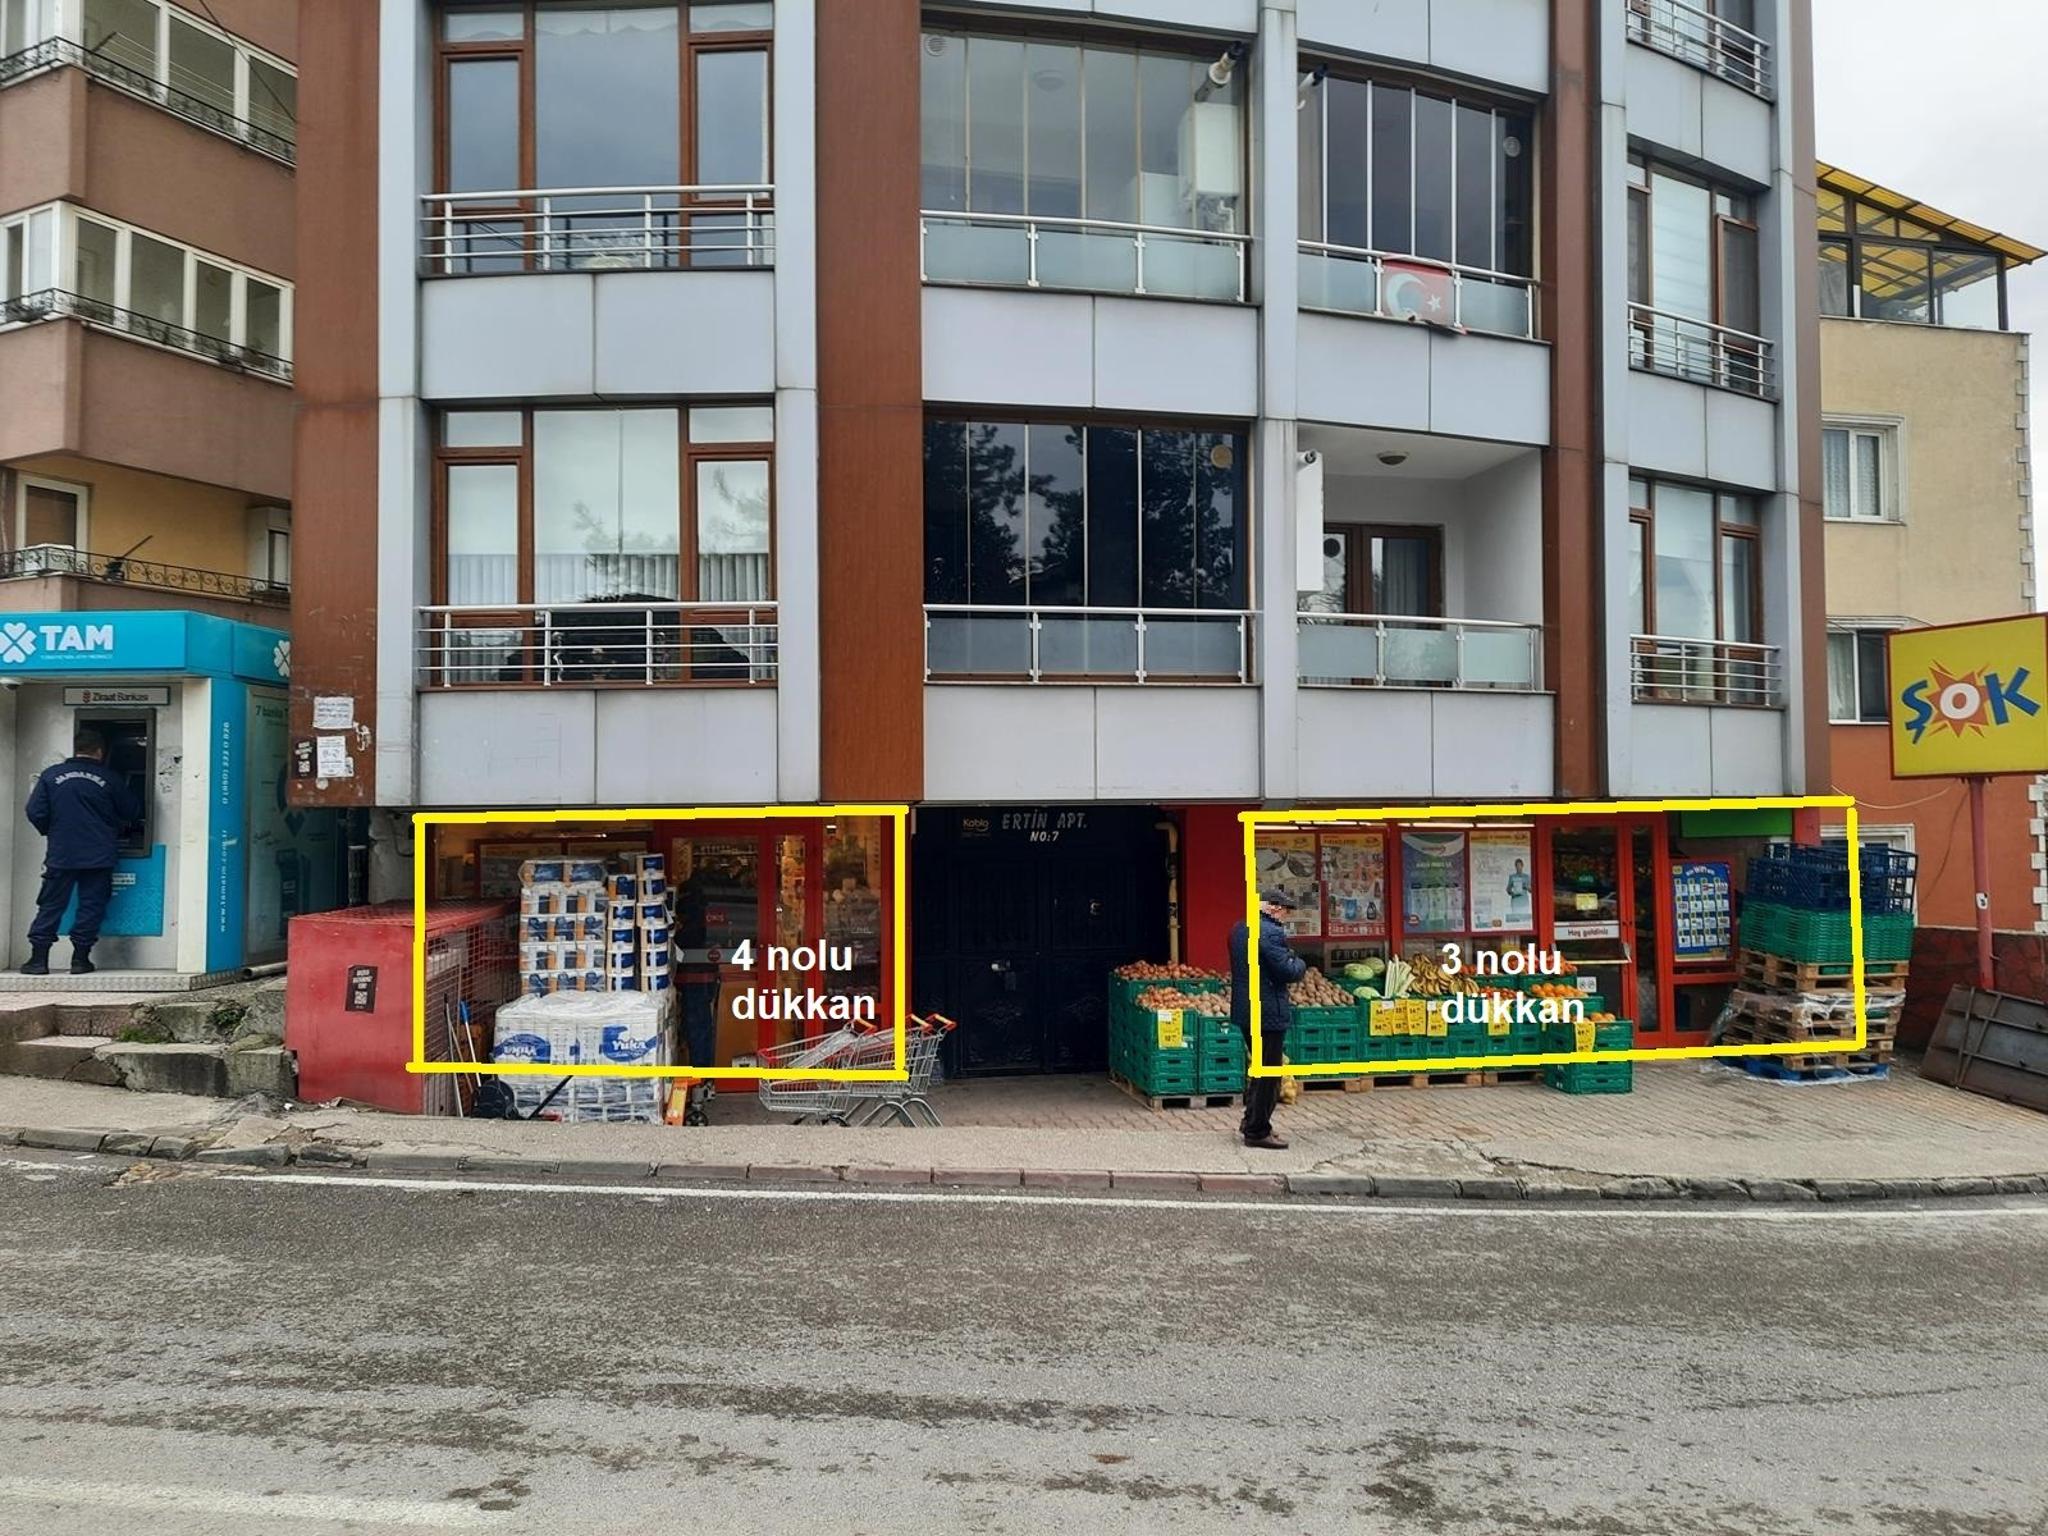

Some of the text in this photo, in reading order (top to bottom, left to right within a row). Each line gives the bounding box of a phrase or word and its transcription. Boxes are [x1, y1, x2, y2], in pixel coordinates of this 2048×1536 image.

[39, 625, 114, 651] TAM
[93, 692, 116, 701] Ziraat
[1902, 667, 2041, 744] ŞOK
[1002, 808, 1088, 830] ERTİN APT.
[1029, 831, 1060, 842] NO:7
[612, 1038, 647, 1051] Yuka
